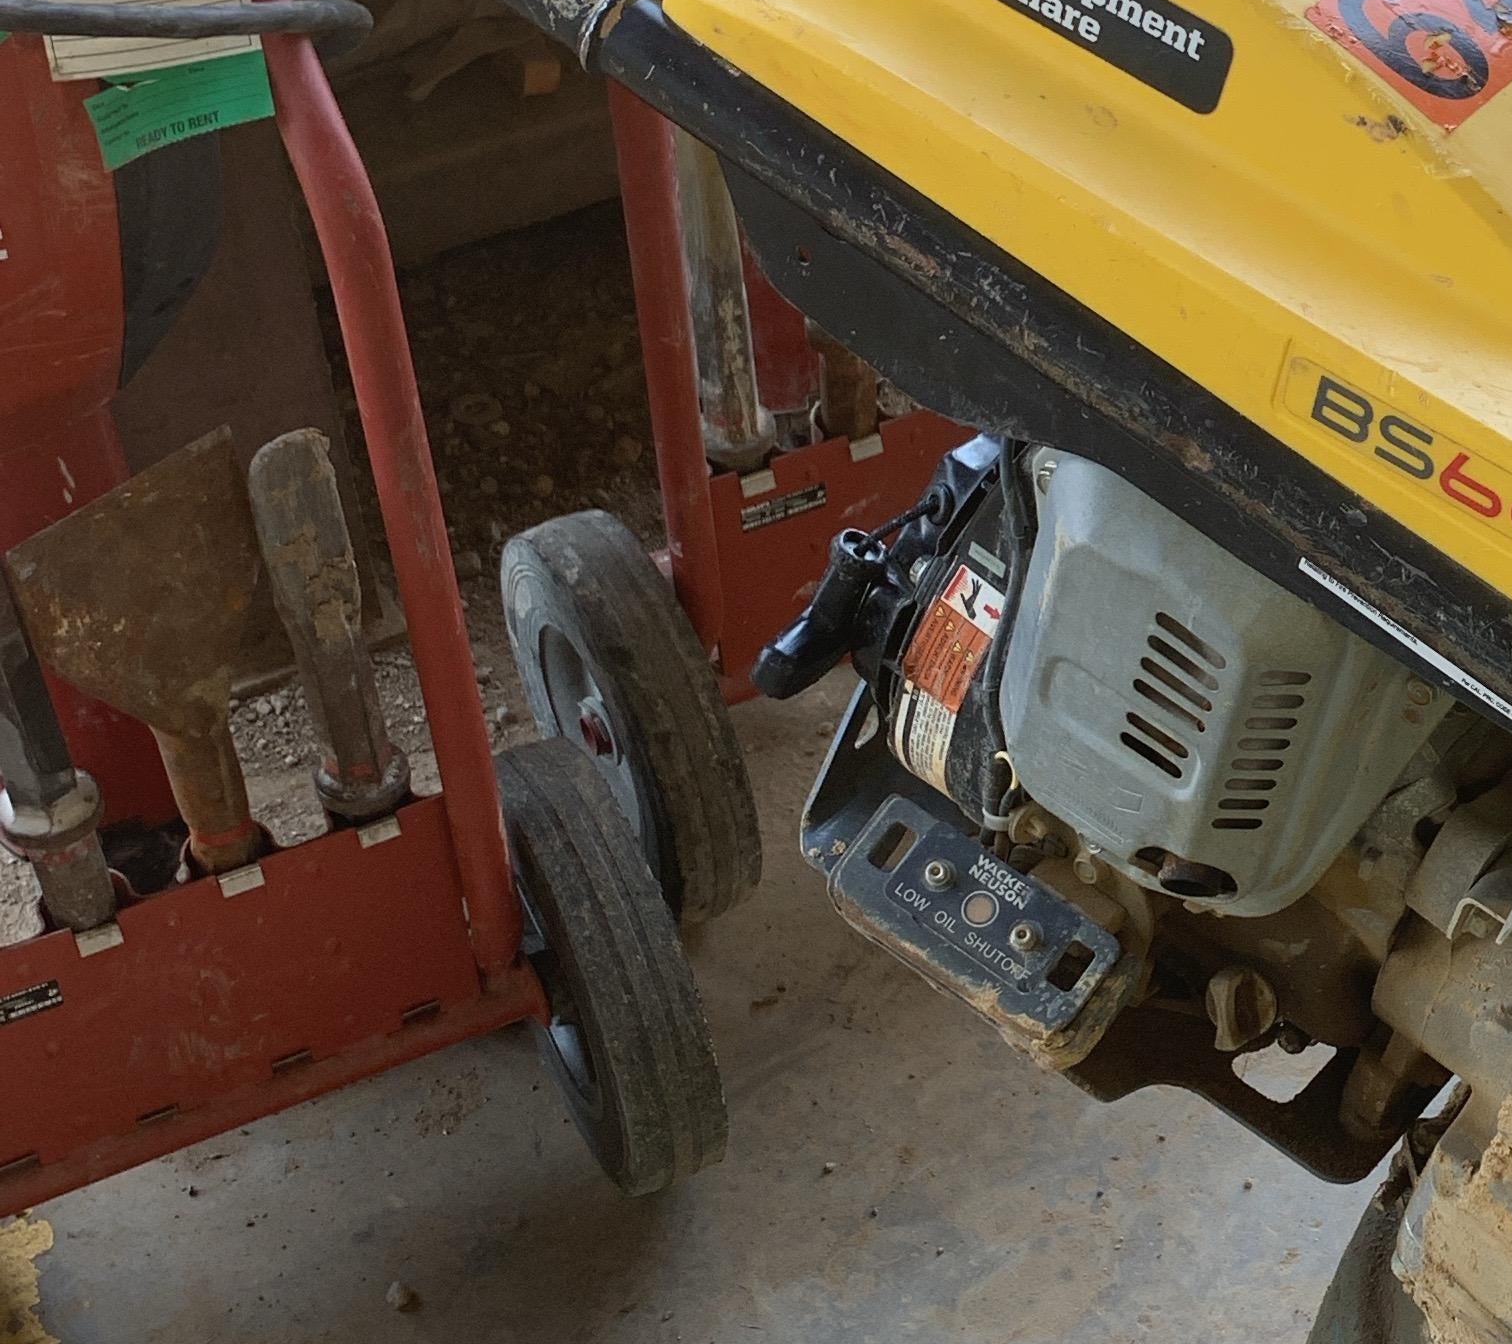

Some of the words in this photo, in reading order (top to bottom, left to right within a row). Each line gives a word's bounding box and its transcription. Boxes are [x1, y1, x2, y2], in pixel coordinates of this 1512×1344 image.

[136, 126, 167, 150] READY
[171, 120, 185, 136] TO
[188, 110, 220, 130] RENT
[894, 882, 931, 912] LOW
[934, 910, 958, 934] OIL
[968, 864, 1029, 910] NEUSON
